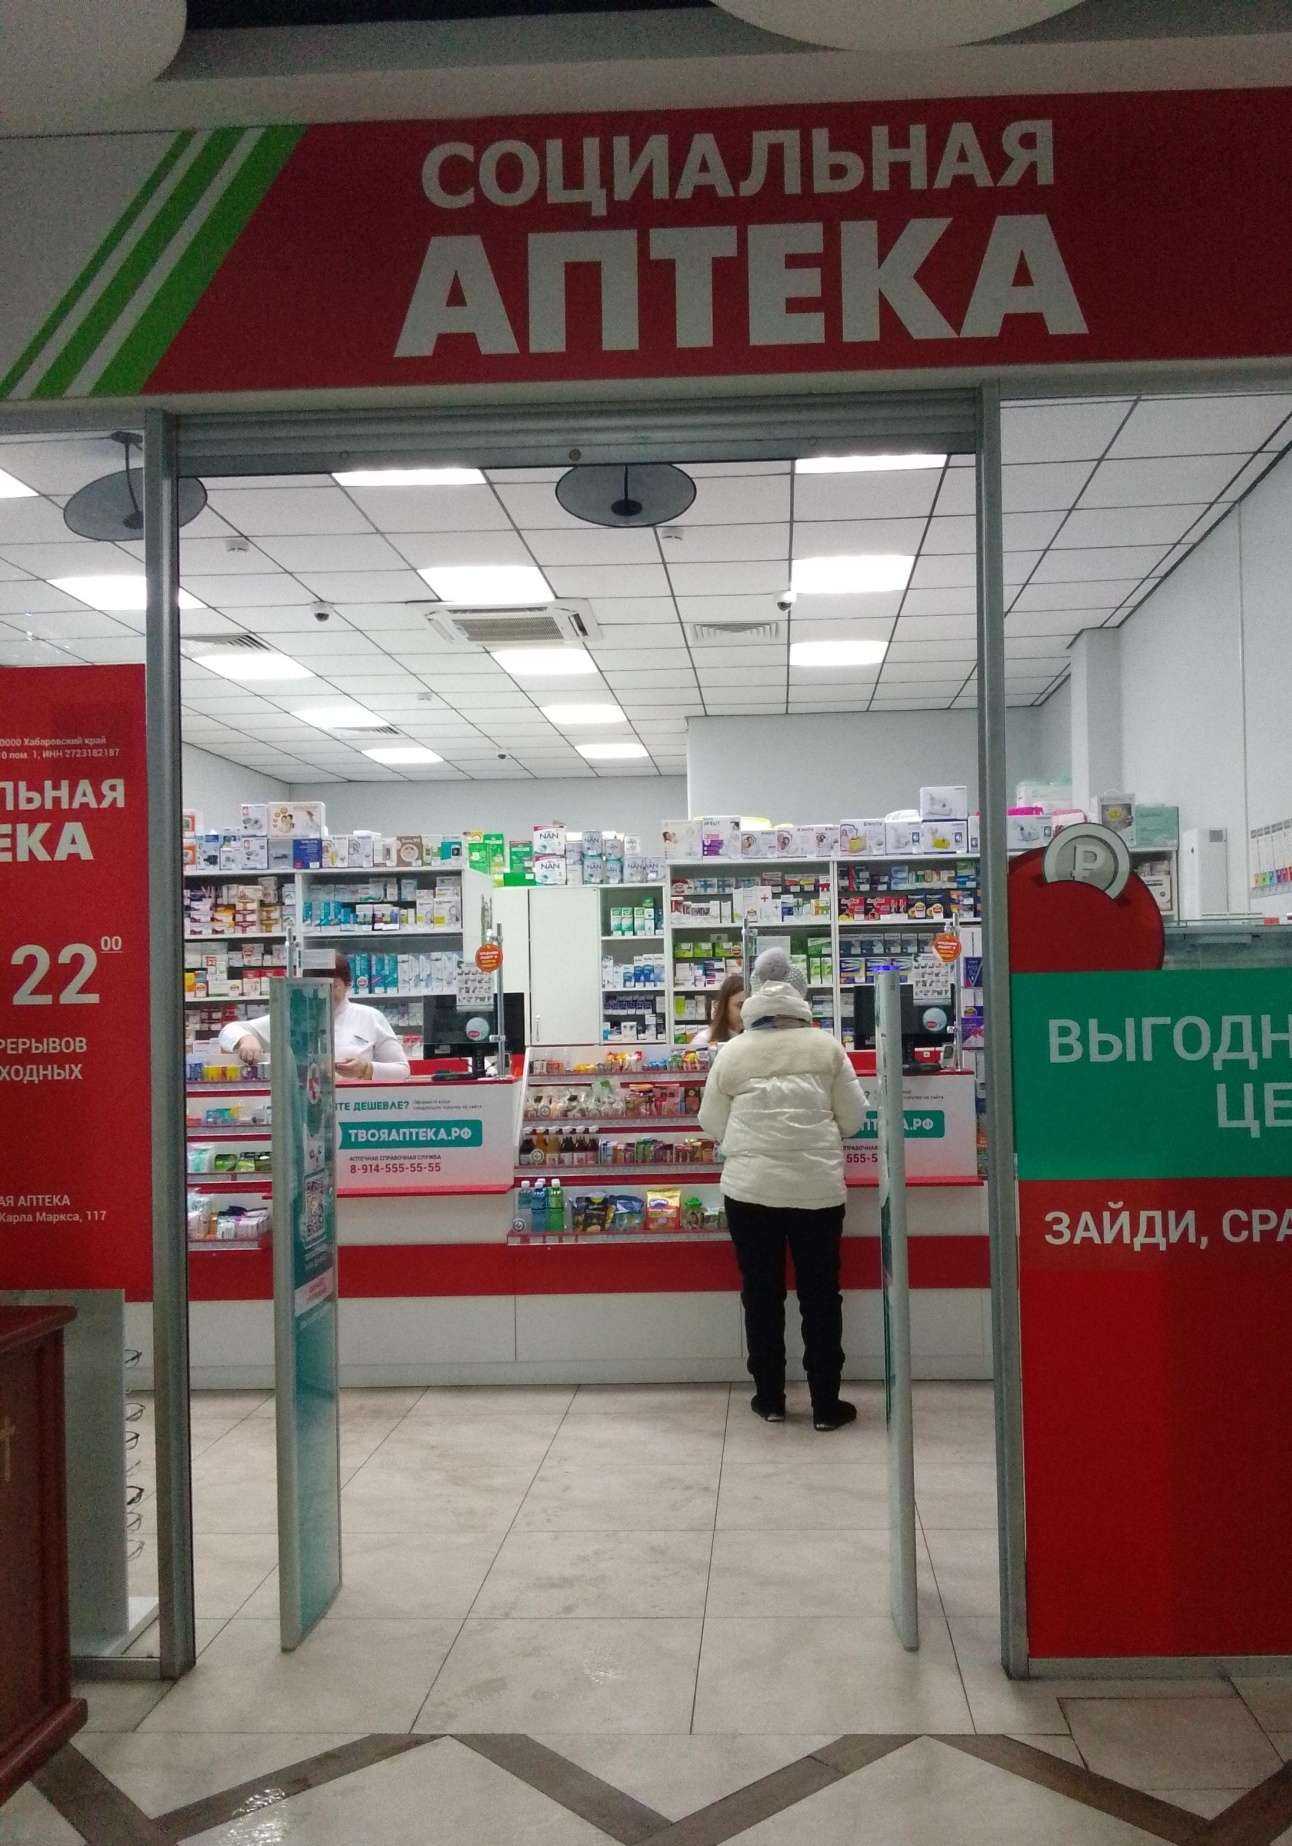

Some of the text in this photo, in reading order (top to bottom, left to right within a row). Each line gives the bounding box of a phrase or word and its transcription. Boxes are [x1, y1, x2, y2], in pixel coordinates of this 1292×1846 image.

[421, 119, 1055, 216] СОЦИАЛЬНАЯ
[393, 214, 1090, 358] АПТЕКА
[43, 748, 62, 758] ИНН
[10, 936, 123, 1006] 22 00
[1048, 1014, 1292, 1072] ВЫГОДН
[0, 1064, 83, 1085] ХОДНЫХ
[353, 1100, 409, 1112] ДЕШЕВЛЕ?
[1216, 1082, 1292, 1138] ЦЕ
[348, 1127, 472, 1142] ТВОЯАПТЕКА.РФ
[350, 1162, 441, 1175] 8-914-555-55-55
[18, 1194, 71, 1207] АПТЕКА
[0, 1210, 107, 1225] Карла Маркса, 117
[1044, 1200, 1208, 1252] ЗАЙДИ,
